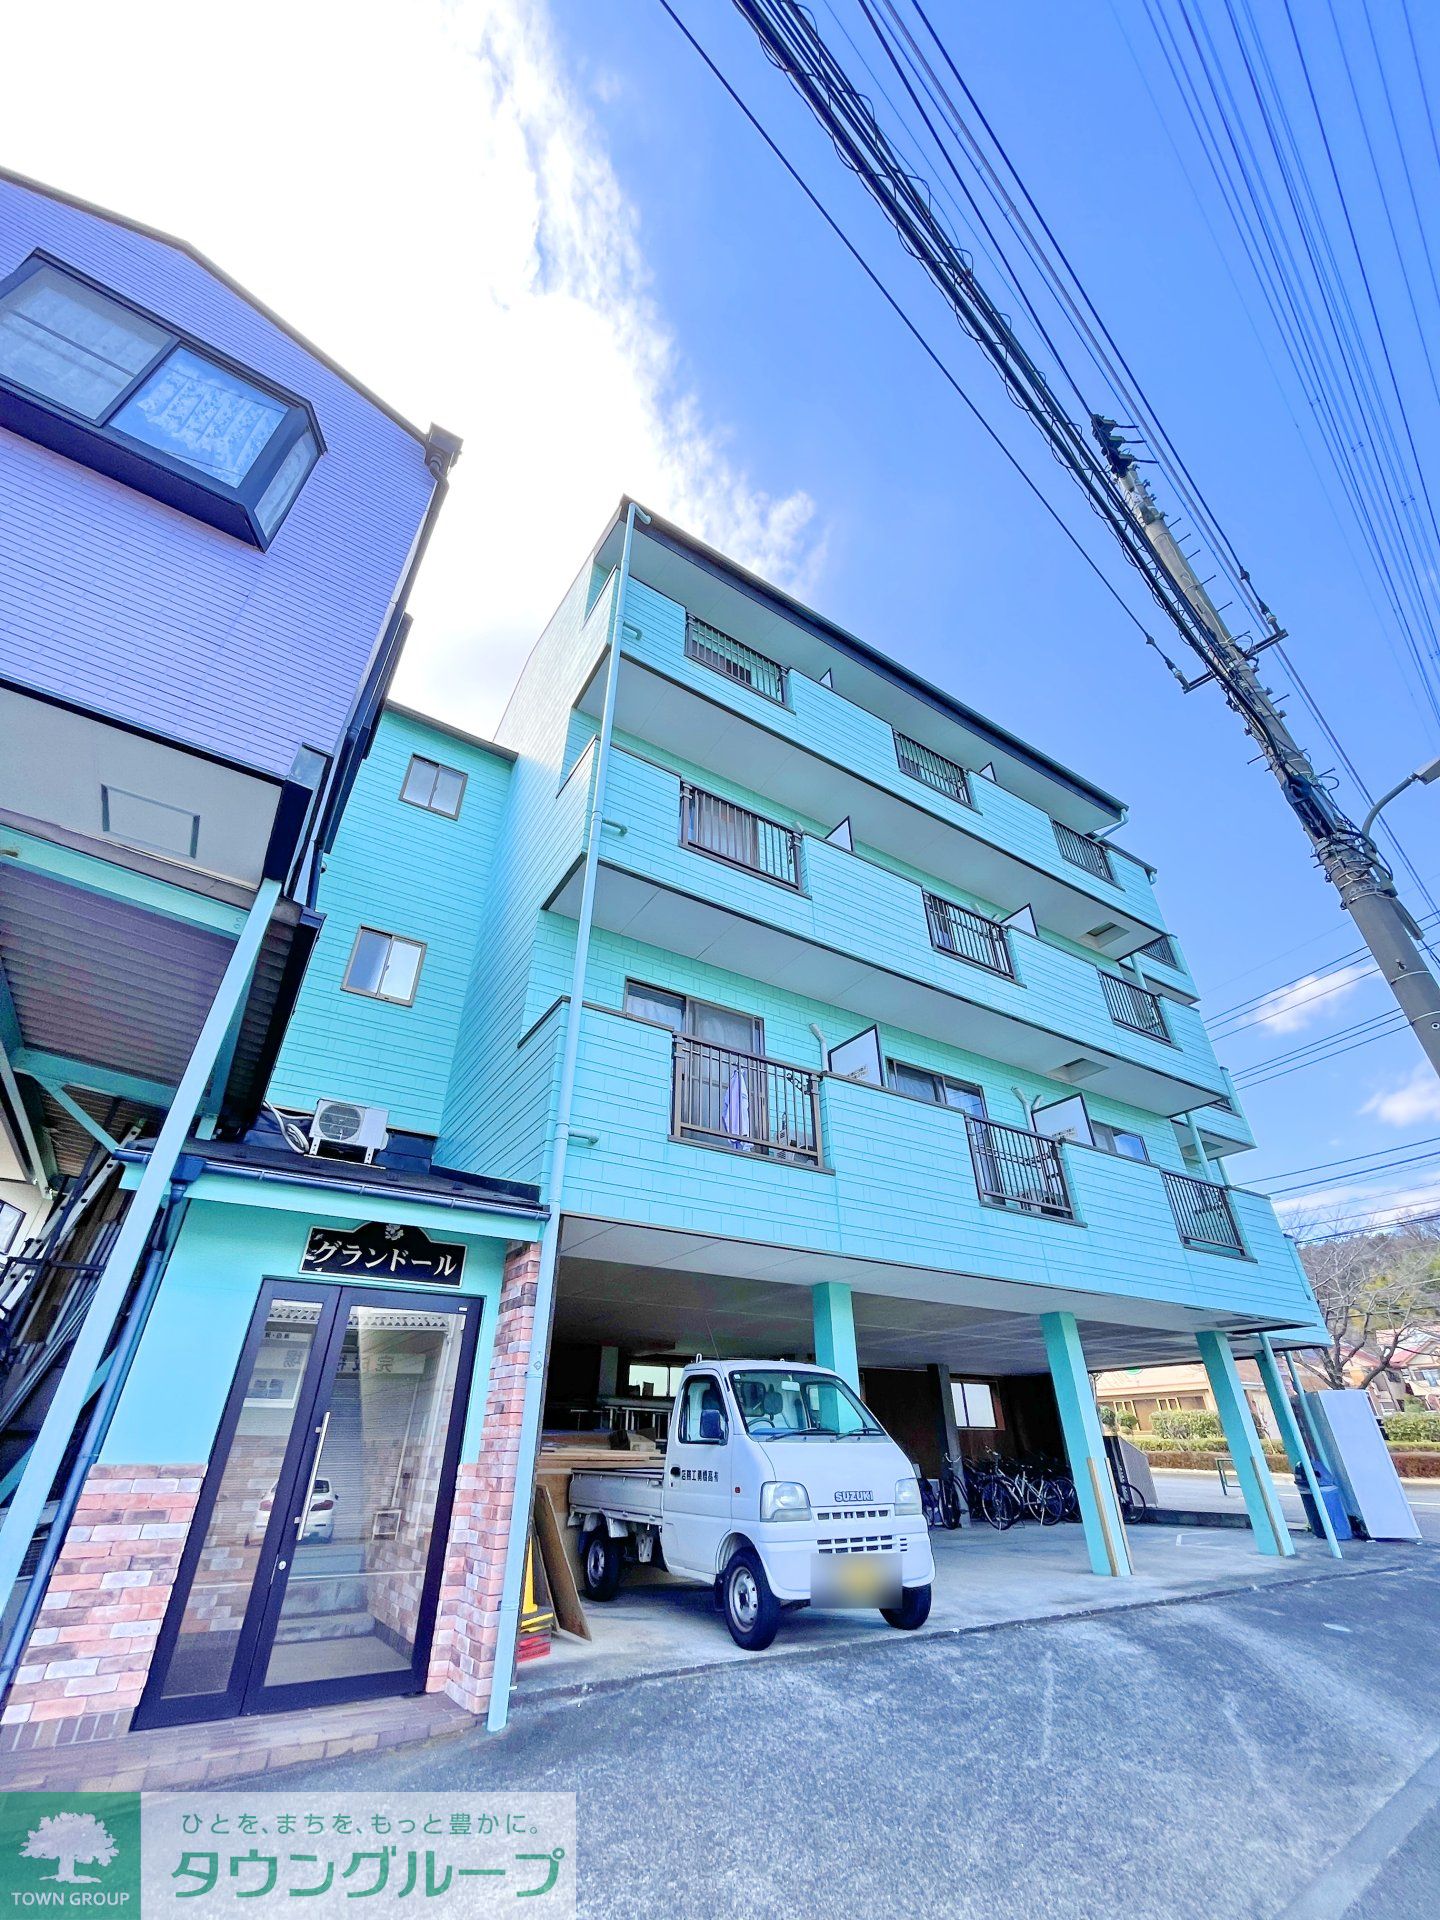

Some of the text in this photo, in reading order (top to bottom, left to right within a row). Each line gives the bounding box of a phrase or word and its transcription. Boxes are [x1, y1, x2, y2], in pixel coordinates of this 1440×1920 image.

[313, 1240, 457, 1276] グランドール
[834, 1490, 874, 1502] SUZUKI
